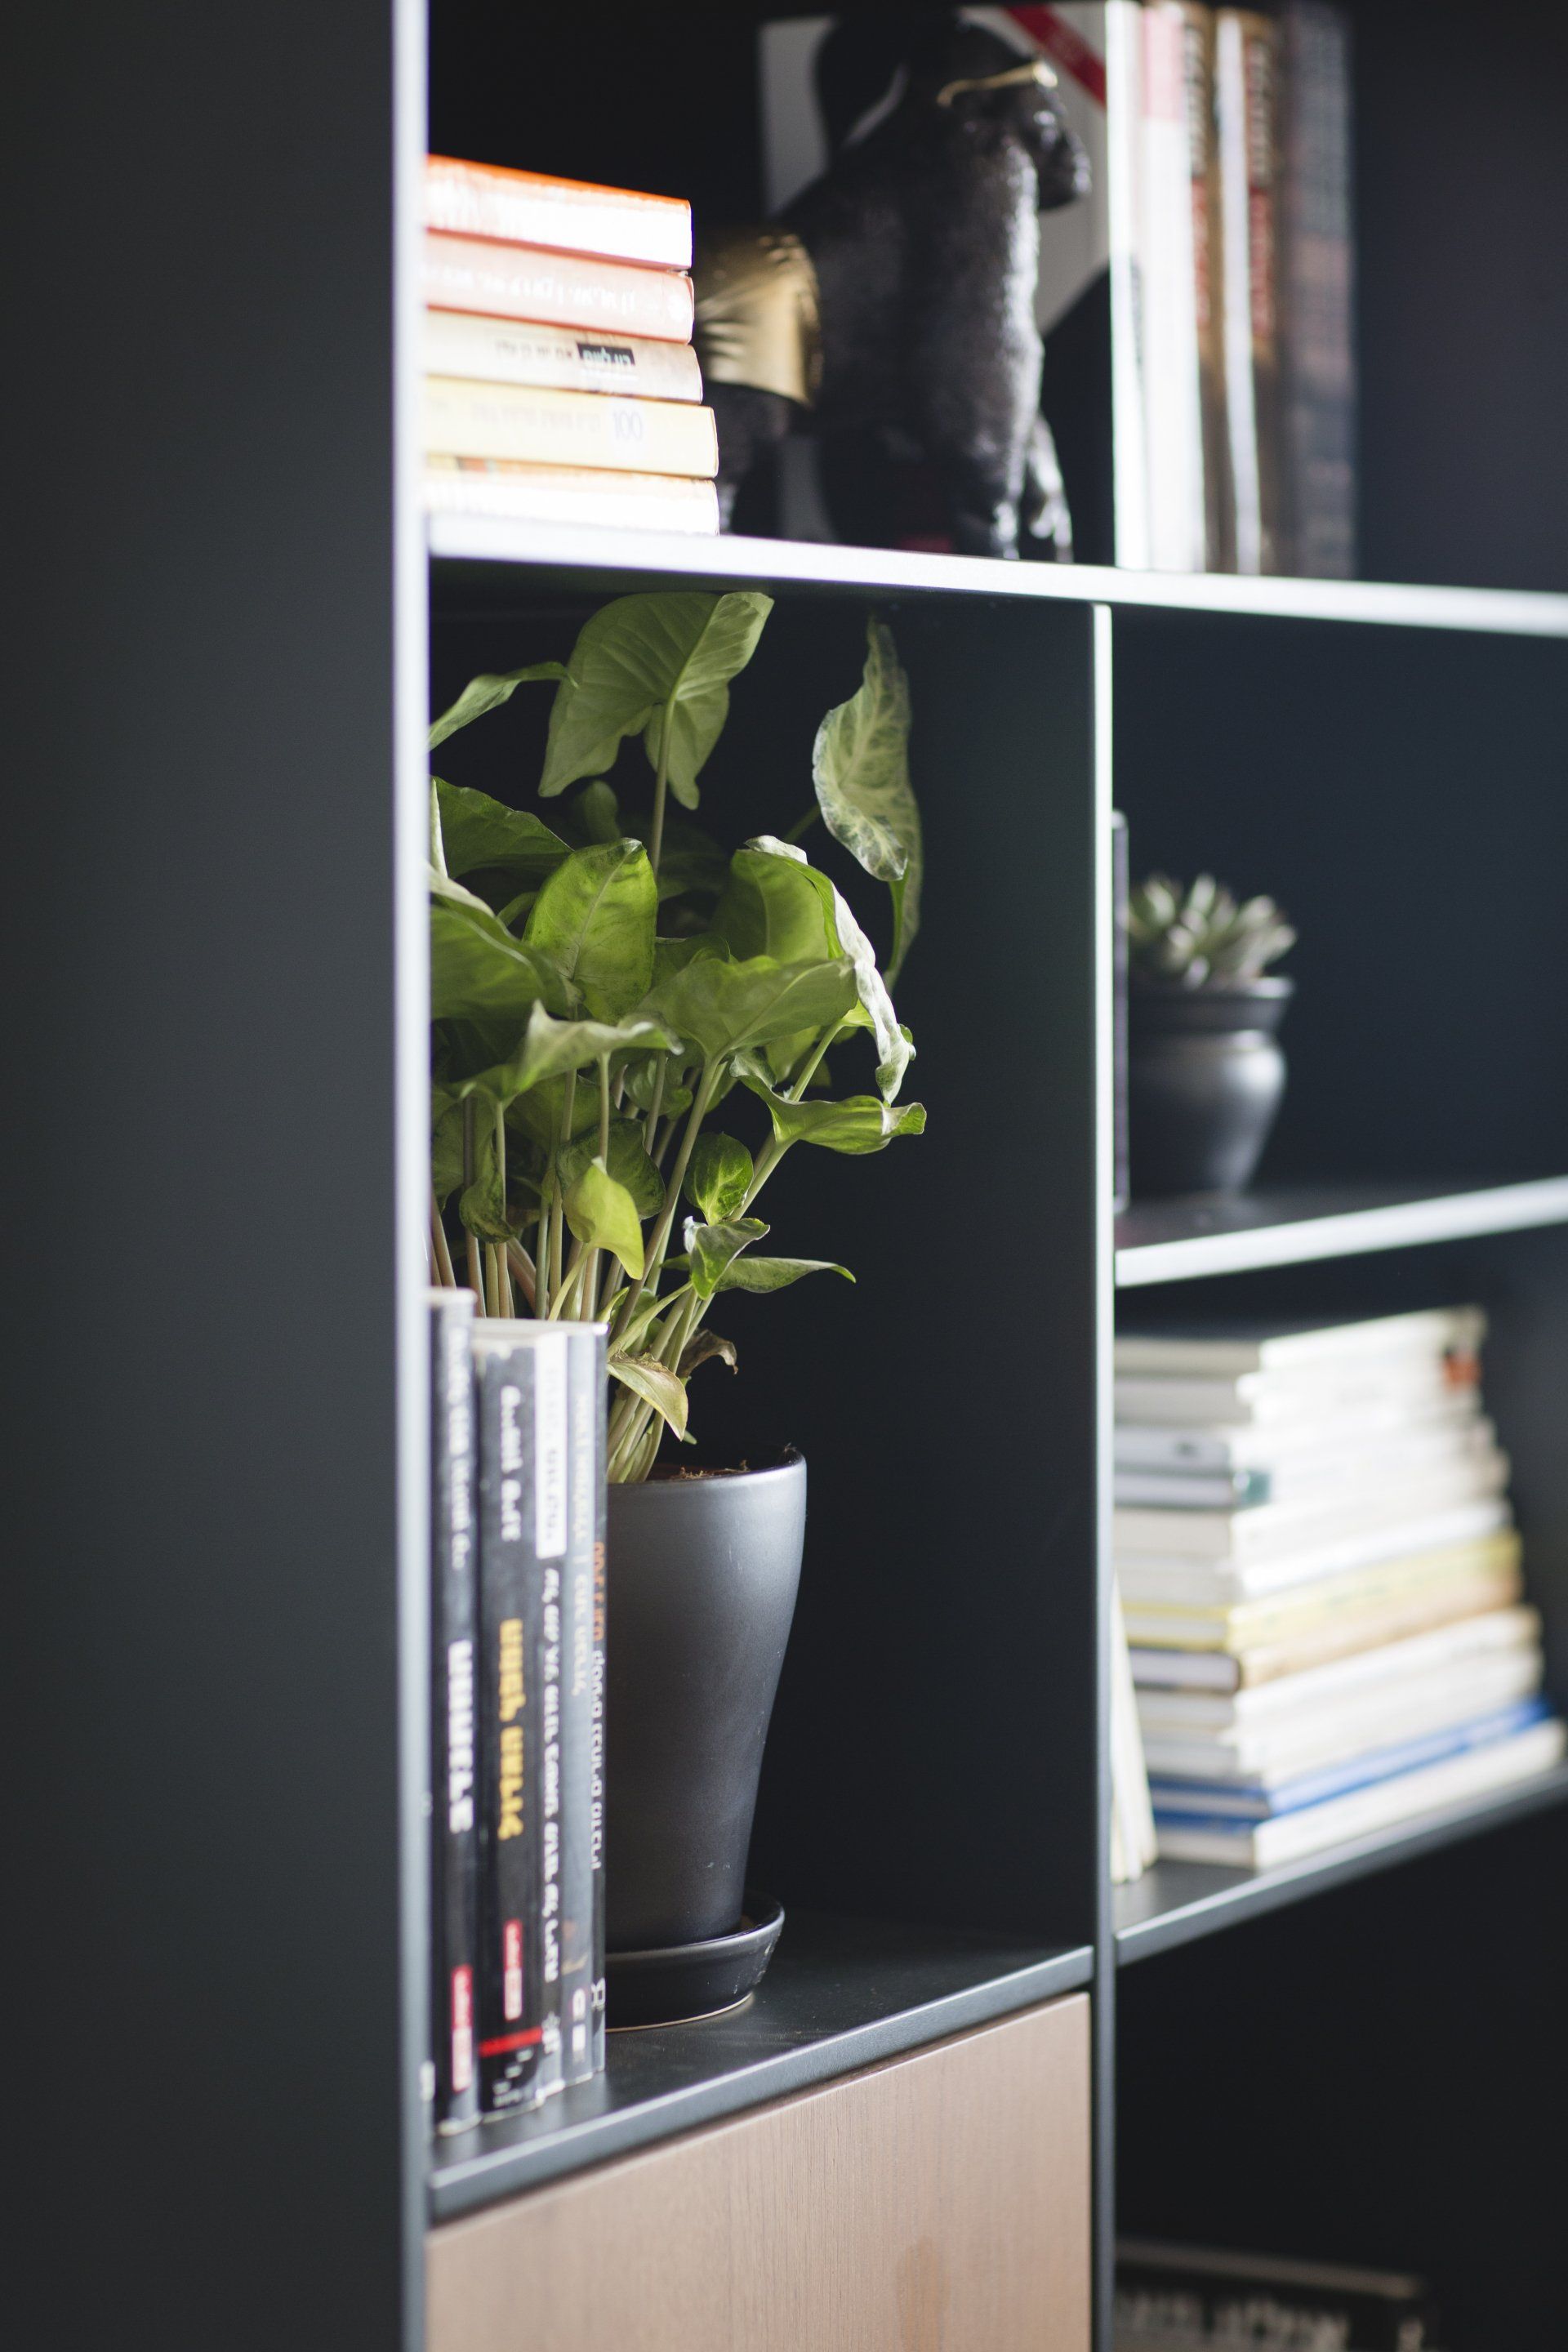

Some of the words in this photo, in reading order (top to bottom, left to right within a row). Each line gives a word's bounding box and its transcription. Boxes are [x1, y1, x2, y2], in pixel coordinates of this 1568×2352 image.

[612, 409, 644, 442] 100
[498, 1619, 526, 1722] המפץ
[448, 1640, 474, 1834] המתנדב
[590, 1722, 603, 1797] נבחרים
[497, 1726, 525, 1840] הגדול
[544, 1821, 559, 1882] מדבר
[544, 1918, 559, 1983] ריצה
